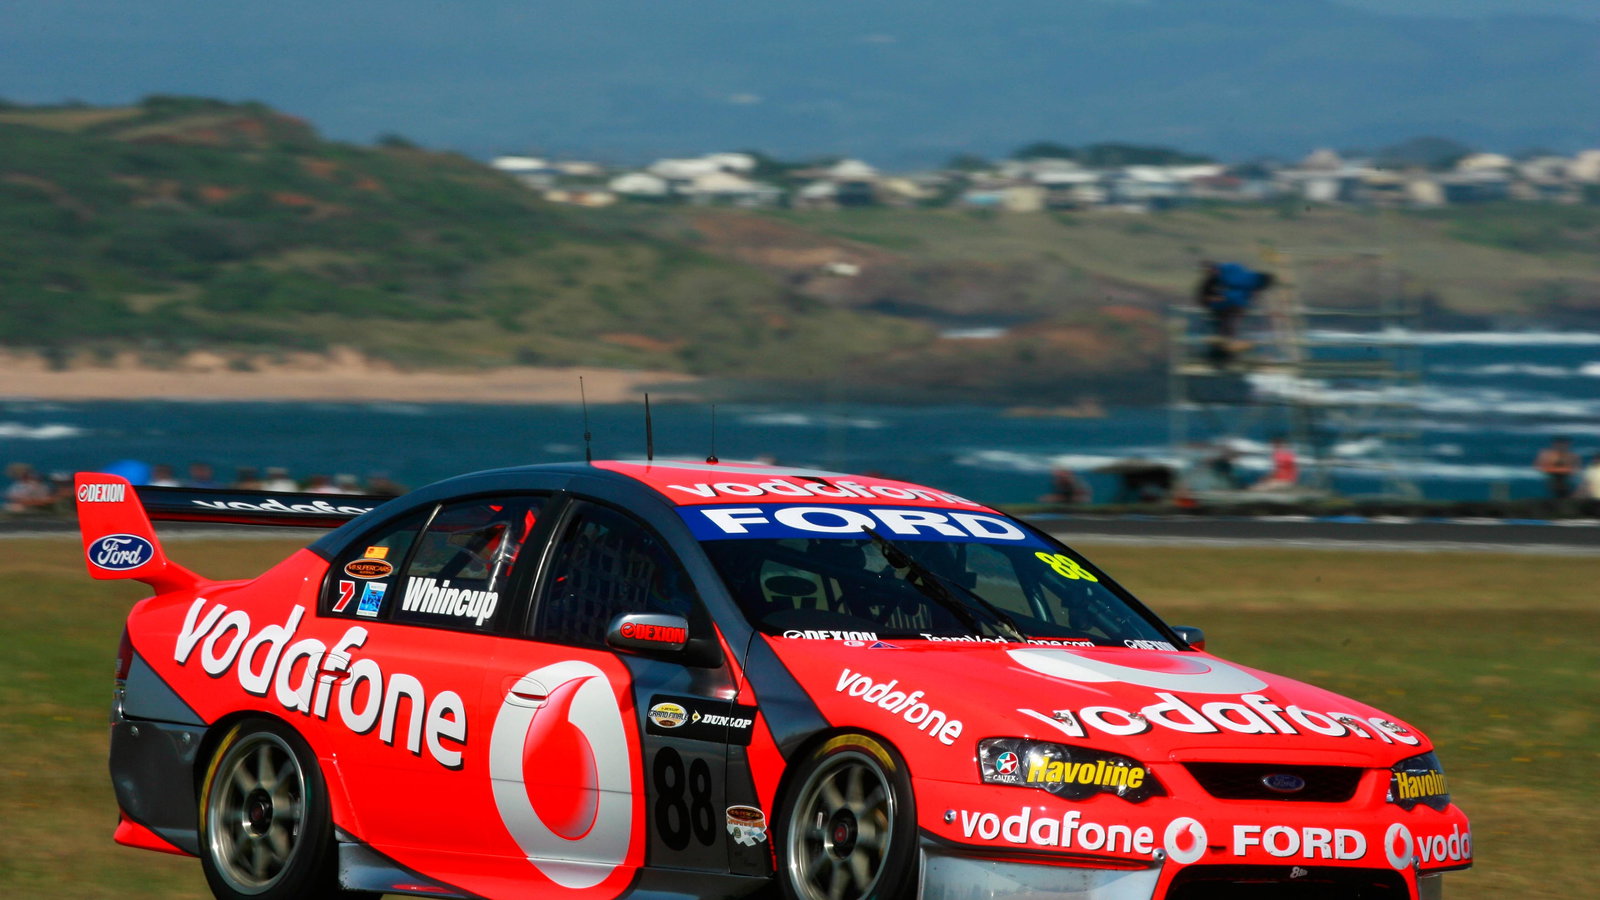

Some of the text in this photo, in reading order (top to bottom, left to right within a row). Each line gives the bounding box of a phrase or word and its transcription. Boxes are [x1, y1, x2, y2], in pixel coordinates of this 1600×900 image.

[88, 484, 125, 502] DEXION
[667, 479, 981, 507] vodafone
[700, 507, 1026, 540] FORD
[97, 538, 143, 565] Ford
[1034, 552, 1099, 582] 88
[332, 580, 355, 612] 7
[402, 576, 498, 626] Whincup
[635, 624, 686, 644] DEXION
[174, 597, 467, 768] vodafone
[702, 714, 752, 729] DUNLOP
[836, 668, 963, 745] vodafone
[1017, 693, 1419, 746] vodafone
[993, 774, 1017, 782] CALTEX
[1026, 757, 1145, 789] Havoline
[653, 746, 717, 851] 88
[961, 807, 1154, 854] vodafone
[1233, 825, 1367, 860] FORD
